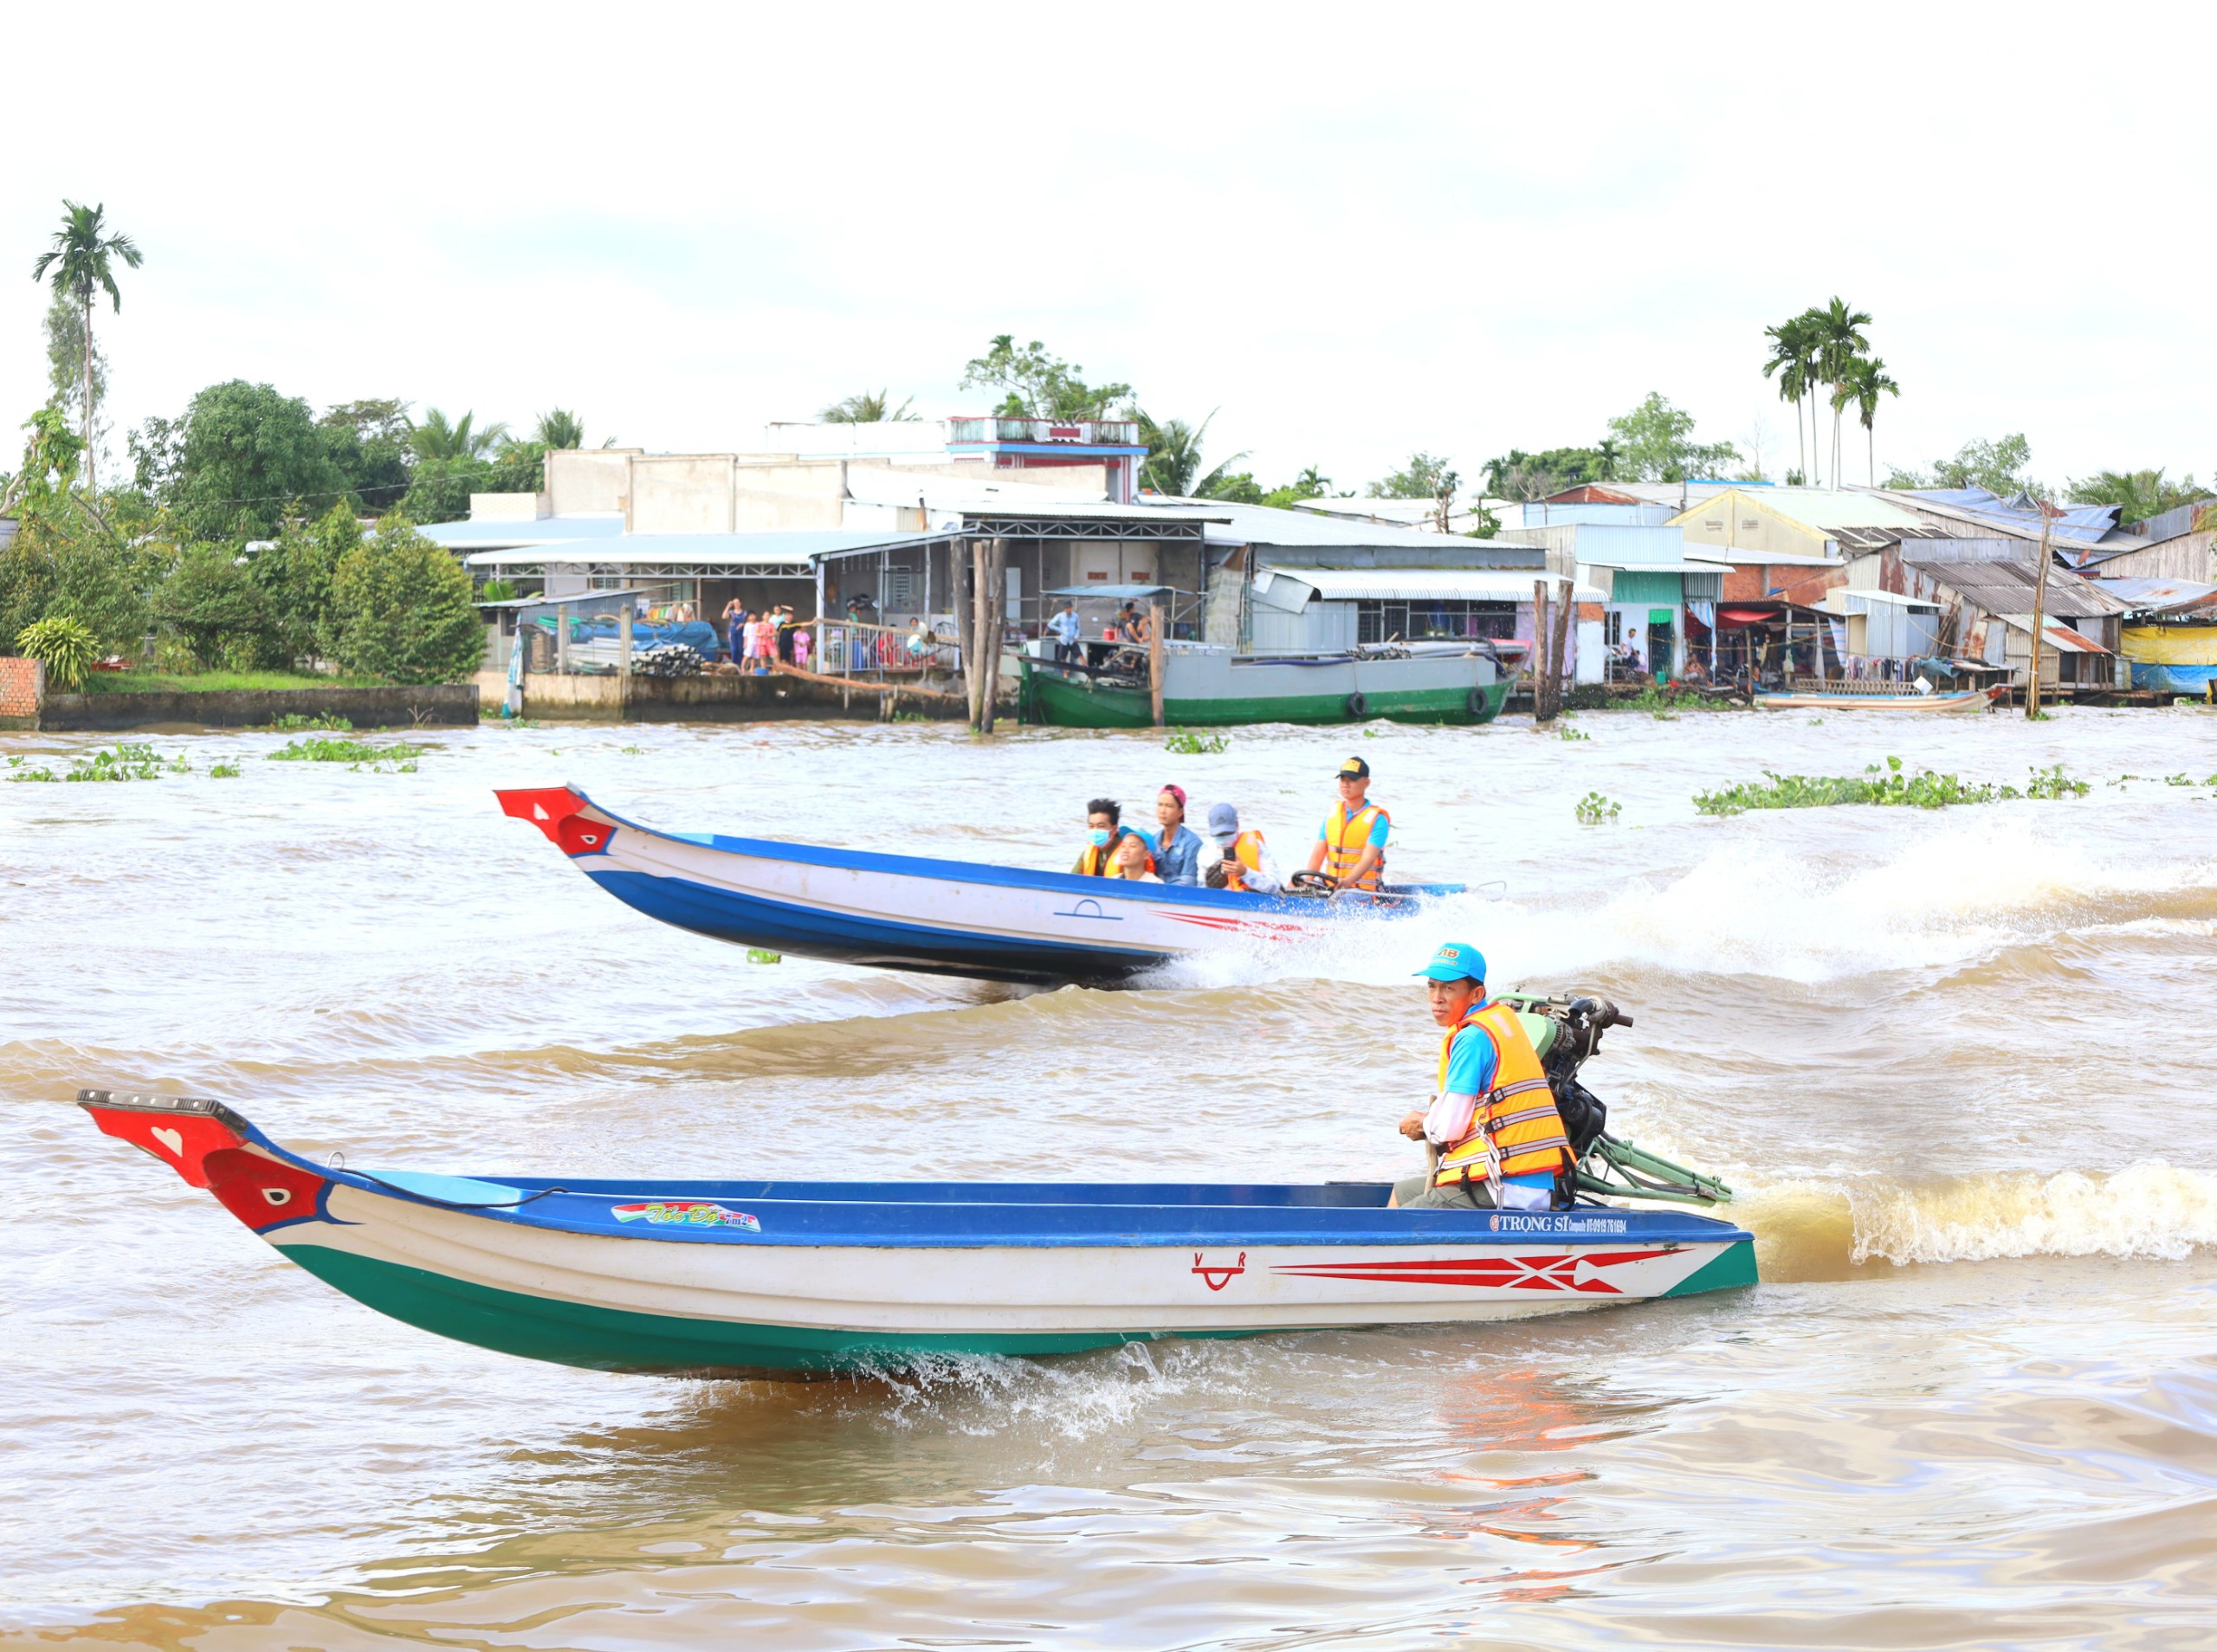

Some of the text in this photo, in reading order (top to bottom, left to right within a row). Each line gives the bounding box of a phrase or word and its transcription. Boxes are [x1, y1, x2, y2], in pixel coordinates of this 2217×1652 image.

[1500, 1216, 1552, 1233] TRỌNG
[1554, 1215, 1569, 1232] SĨ
[1194, 1252, 1203, 1267] V
[1238, 1251, 1246, 1267] R
